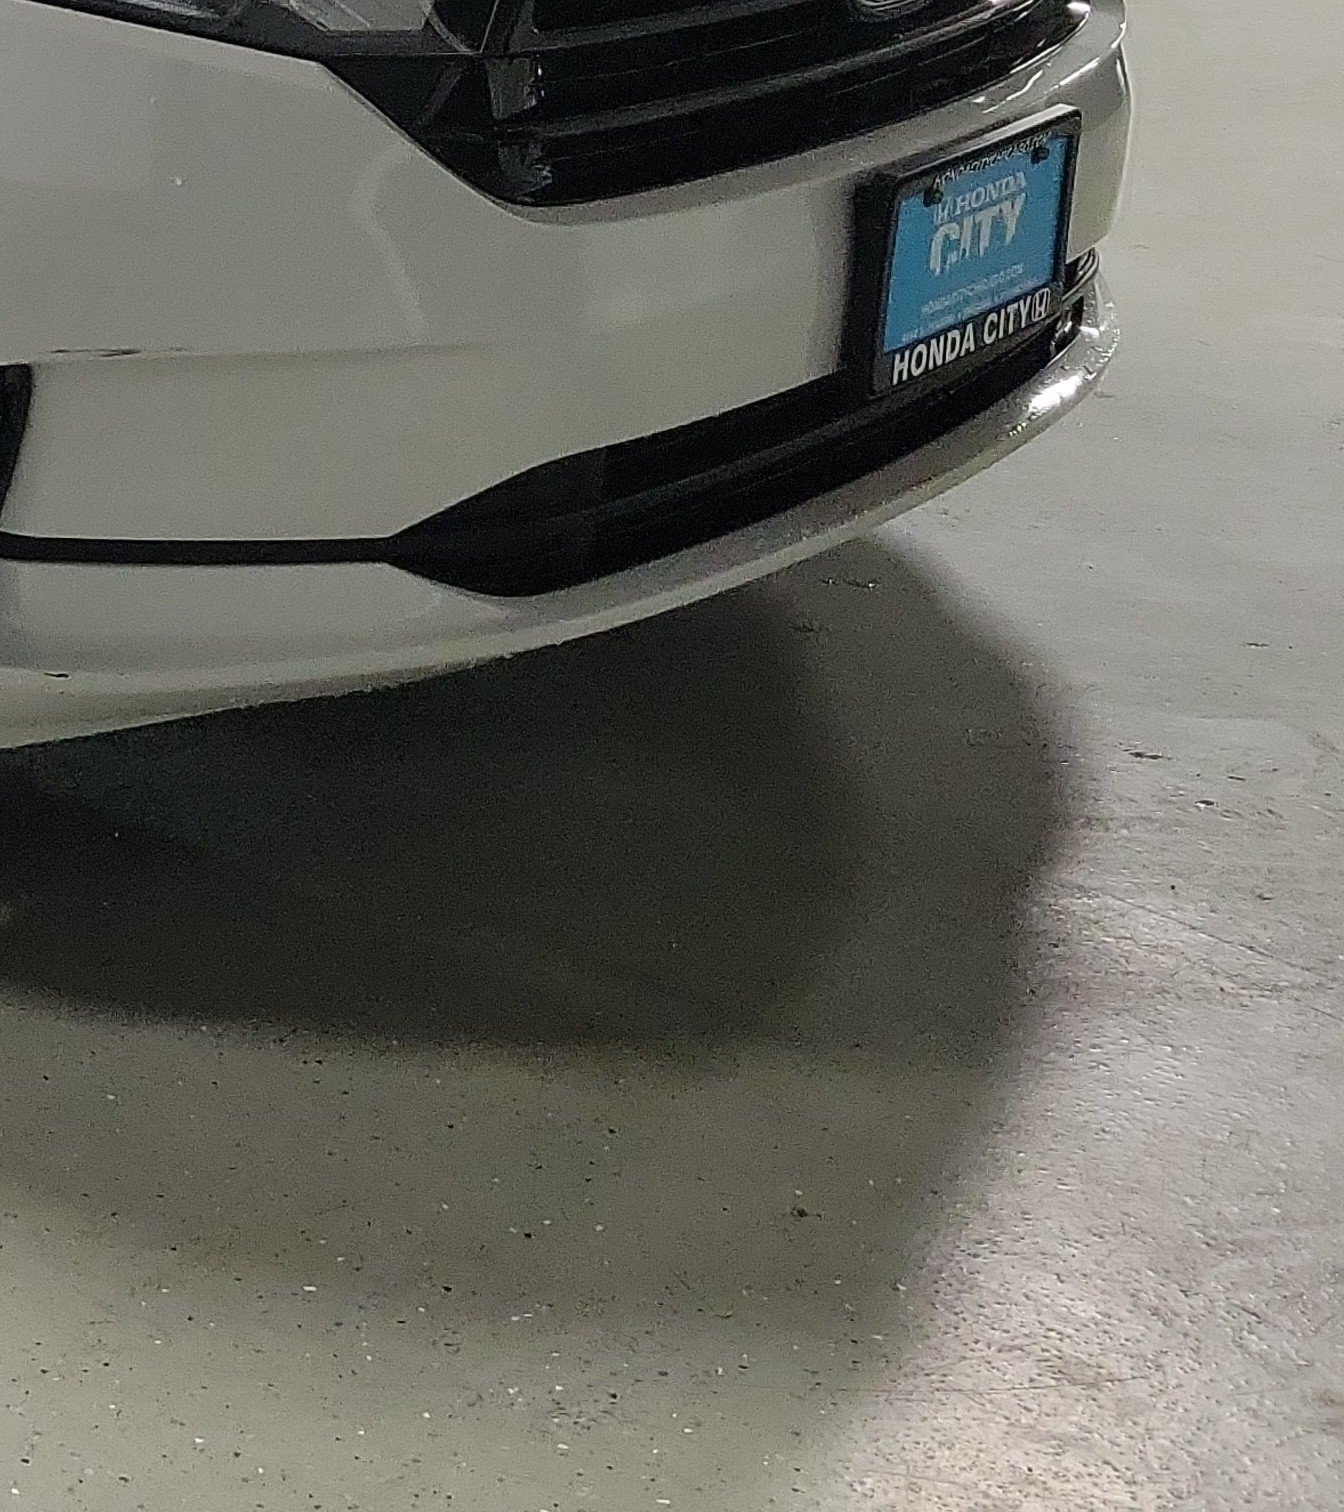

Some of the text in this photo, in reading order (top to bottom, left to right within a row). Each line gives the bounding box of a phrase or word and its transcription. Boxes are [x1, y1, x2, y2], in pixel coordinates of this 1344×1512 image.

[955, 171, 1027, 216] HONDA
[929, 194, 1026, 275] CITY
[892, 326, 976, 386] HONDA
[983, 297, 1031, 345] CITY
